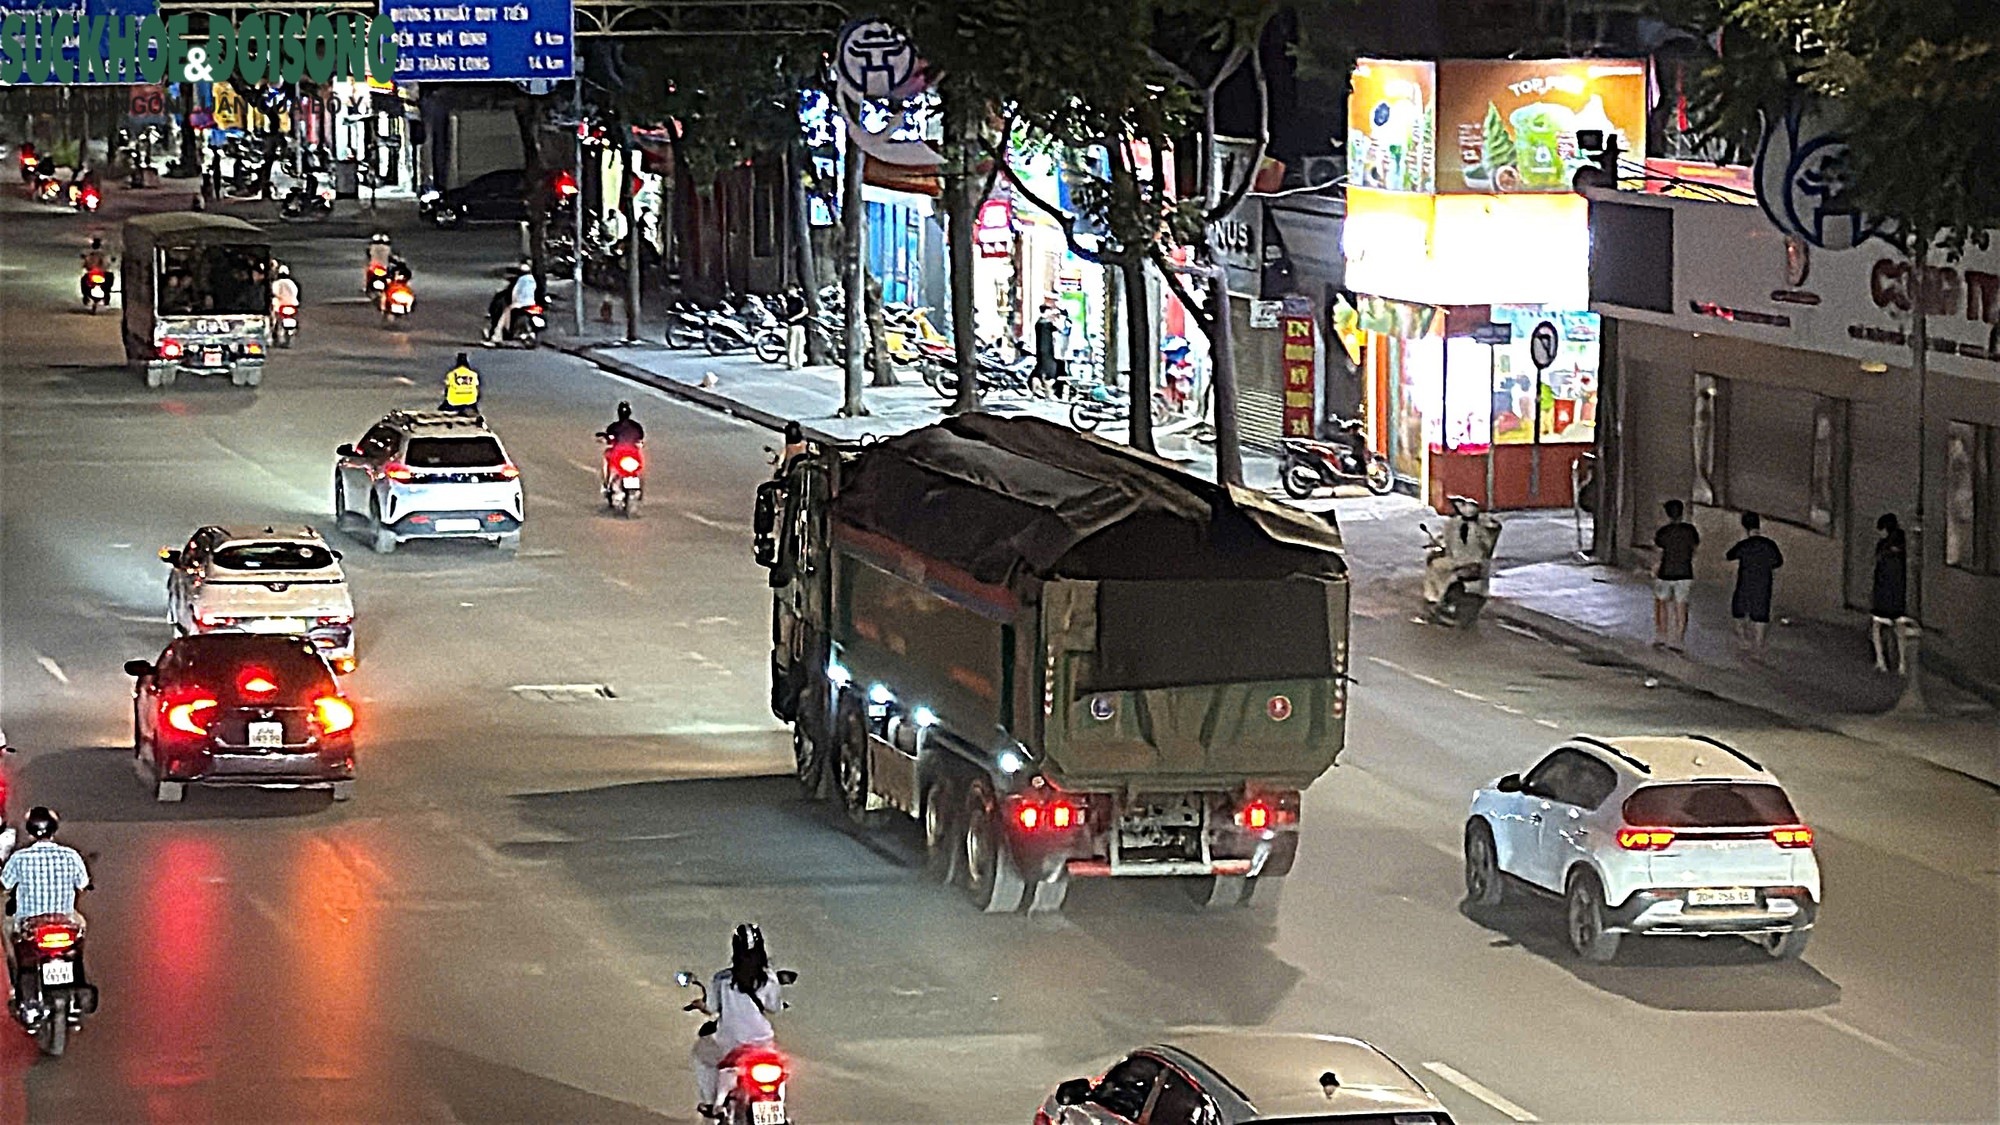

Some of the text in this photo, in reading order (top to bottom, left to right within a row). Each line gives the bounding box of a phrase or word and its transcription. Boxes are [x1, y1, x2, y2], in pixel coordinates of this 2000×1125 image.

[418, 32, 433, 47] XE
[546, 32, 564, 45] km
[459, 56, 490, 71] LONG
[546, 56, 564, 70] km
[1208, 219, 1249, 247] NUS
